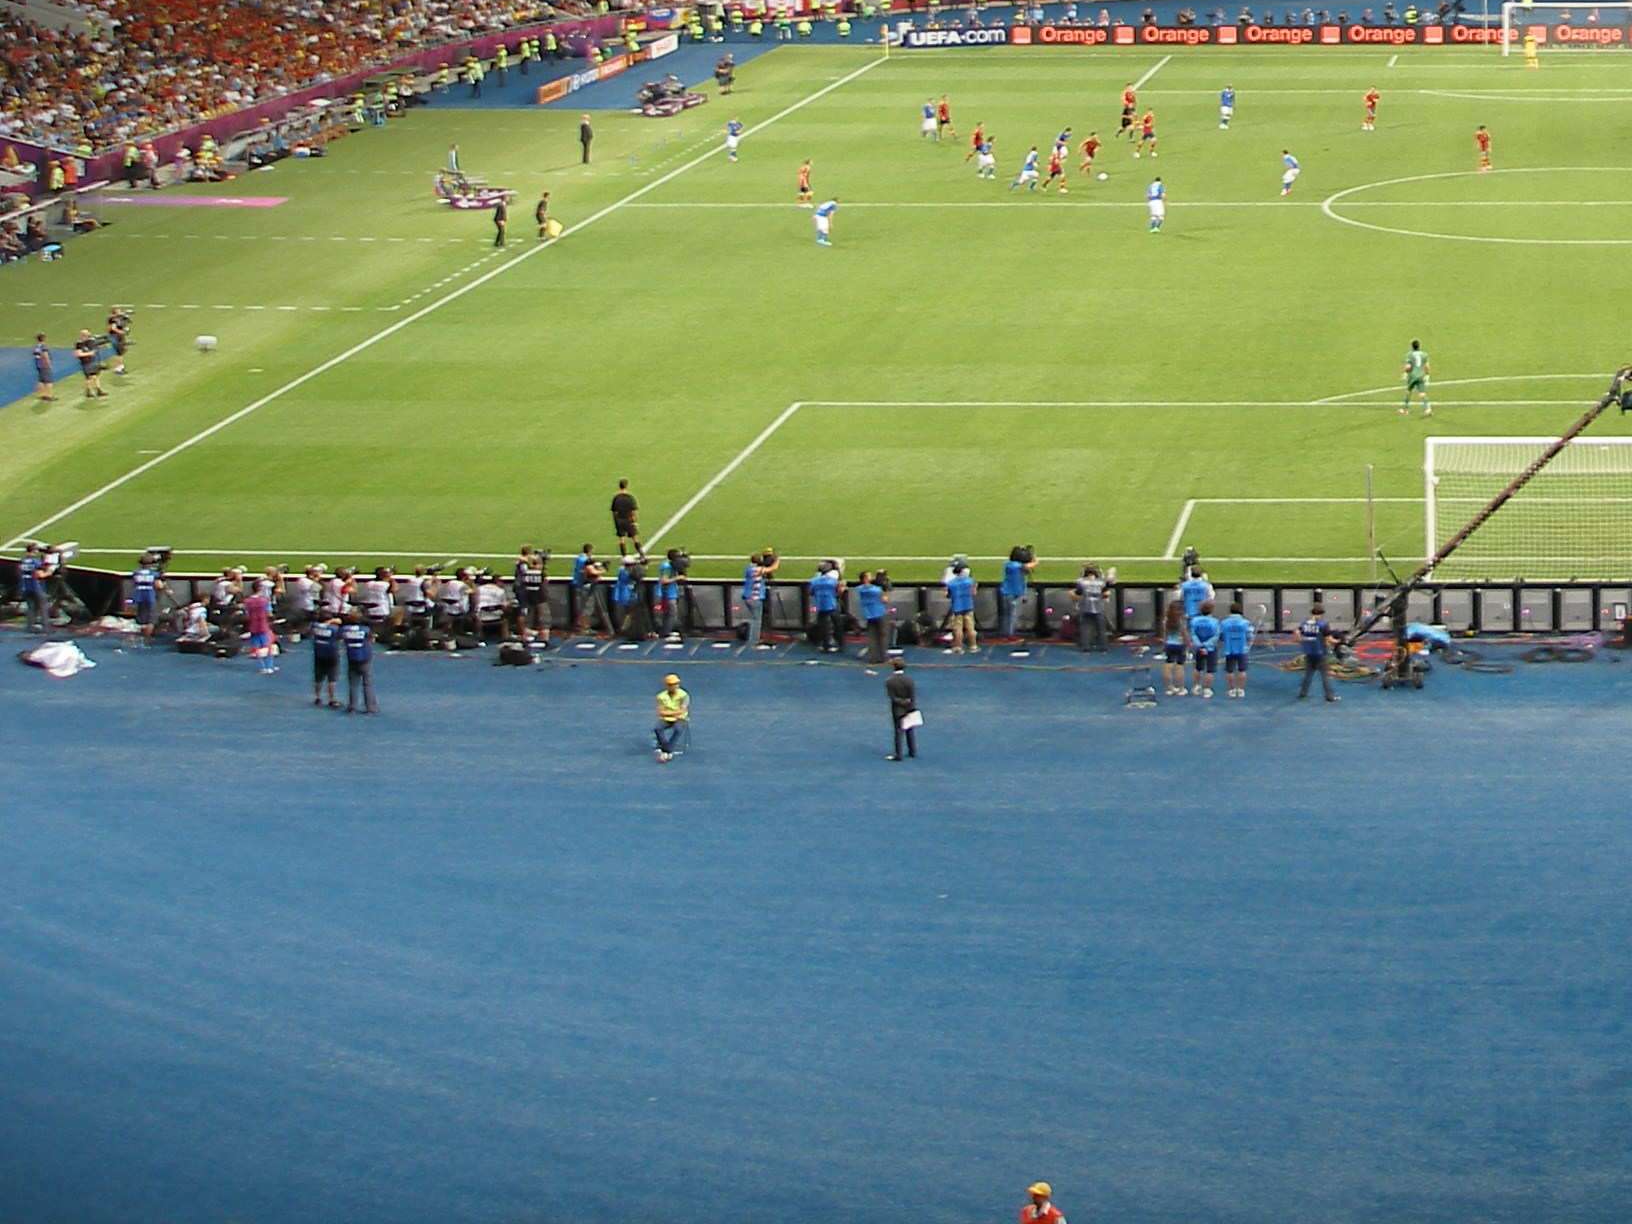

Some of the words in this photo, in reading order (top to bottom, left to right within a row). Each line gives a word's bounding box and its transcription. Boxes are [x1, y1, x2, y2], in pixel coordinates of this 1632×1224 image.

[1041, 26, 1107, 46] Orange
[1143, 26, 1209, 46] Orange
[1246, 26, 1313, 46] Orange
[1349, 26, 1416, 46] Orange
[1452, 26, 1519, 45] Orange
[1556, 25, 1623, 44] Orange
